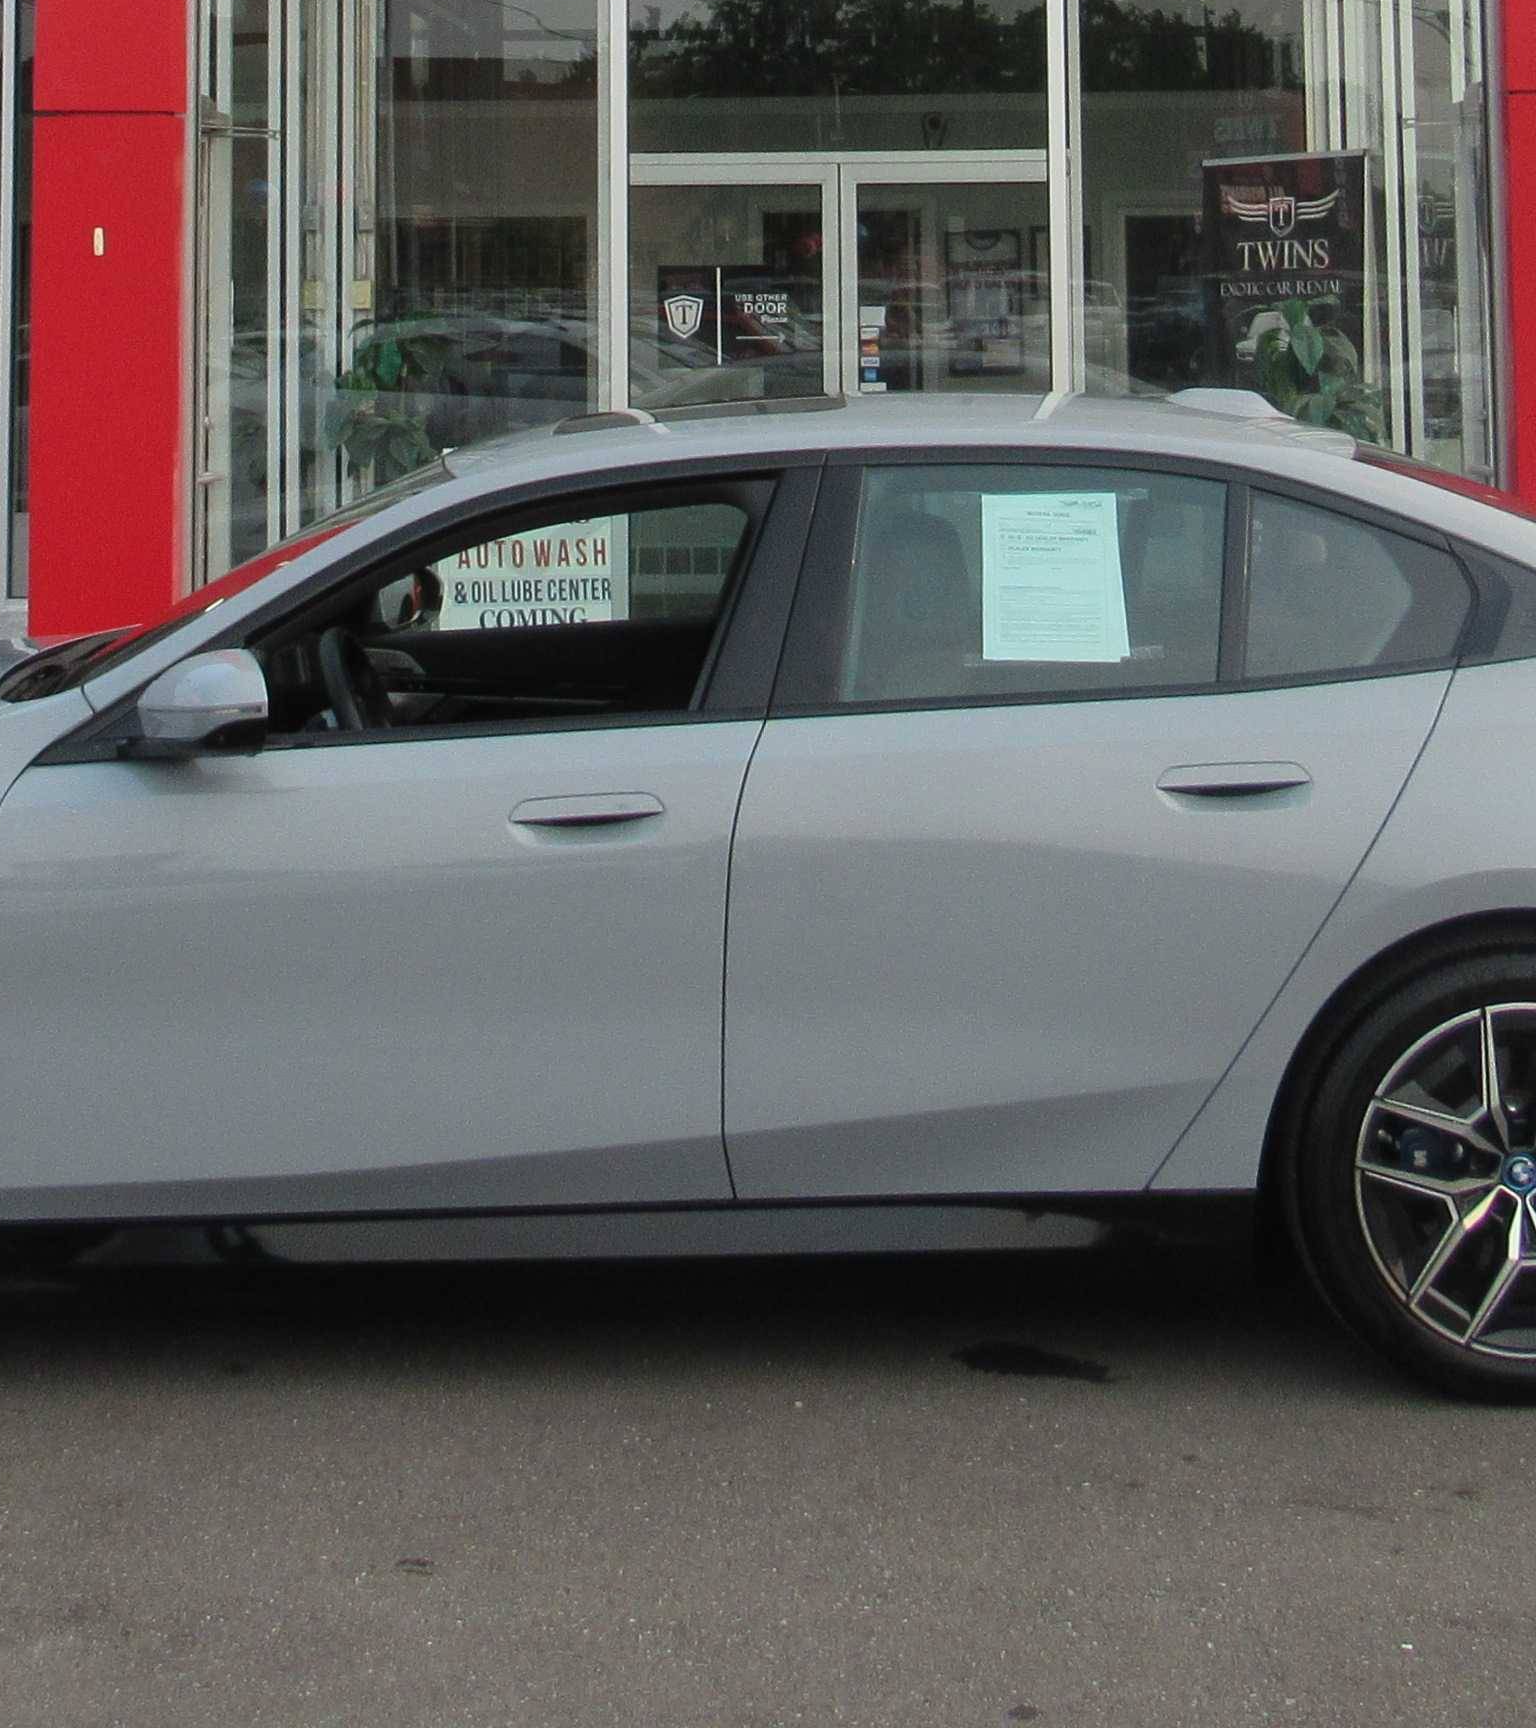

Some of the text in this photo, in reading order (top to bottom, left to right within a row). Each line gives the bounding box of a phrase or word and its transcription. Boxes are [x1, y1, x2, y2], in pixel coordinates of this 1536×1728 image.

[1236, 239, 1329, 271] TWINS
[735, 294, 788, 302] USE OTHER
[1220, 279, 1343, 297] EXOTIC CAR RENTAL
[675, 305, 693, 325] T
[744, 302, 787, 314] DOOR
[458, 538, 606, 569] AUTO WASH
[454, 578, 612, 604] & OIL LUBE CENTER
[479, 607, 588, 628] COMING
